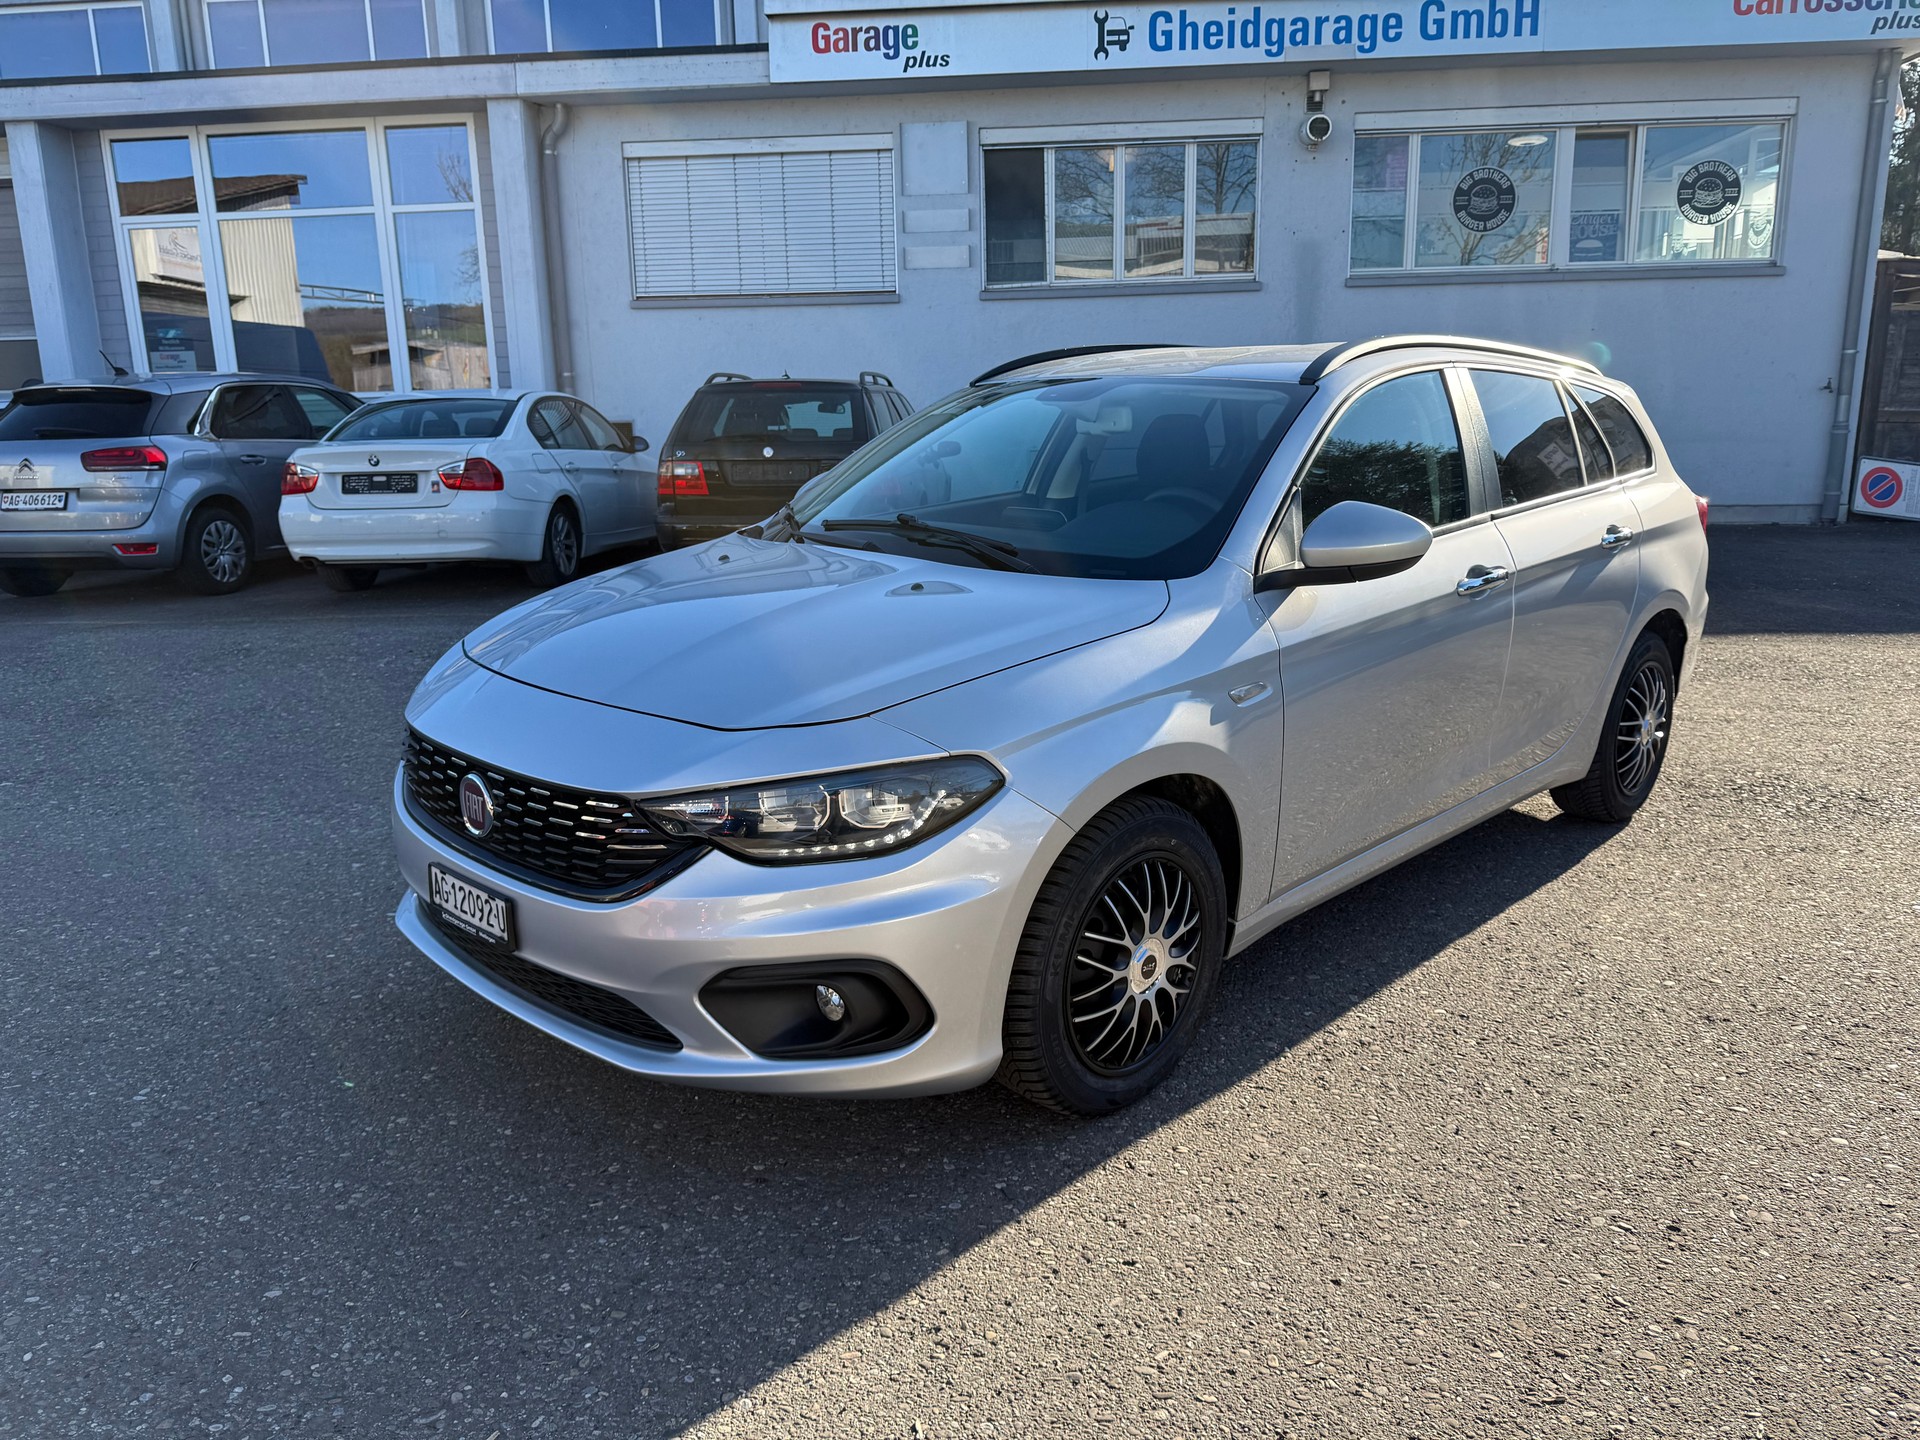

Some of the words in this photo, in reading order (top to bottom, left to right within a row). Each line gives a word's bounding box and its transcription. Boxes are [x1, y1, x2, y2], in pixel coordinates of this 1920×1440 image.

[1148, 6, 1403, 58] Gheidgarage
[1419, 0, 1539, 41] GmbH
[1870, 11, 1920, 35] plus
[811, 21, 919, 60] Garage
[902, 50, 950, 73] plus
[1460, 176, 1474, 190] BIG
[1473, 168, 1511, 189] BROTHERS
[1684, 168, 1698, 183] BIG
[1698, 161, 1737, 182] BROTHERS
[1457, 210, 1484, 231] BURGER
[1486, 208, 1510, 230] HOUSE
[1681, 203, 1709, 225] BURGER
[1709, 201, 1736, 223] HOUSE
[465, 791, 484, 823] FIAT
